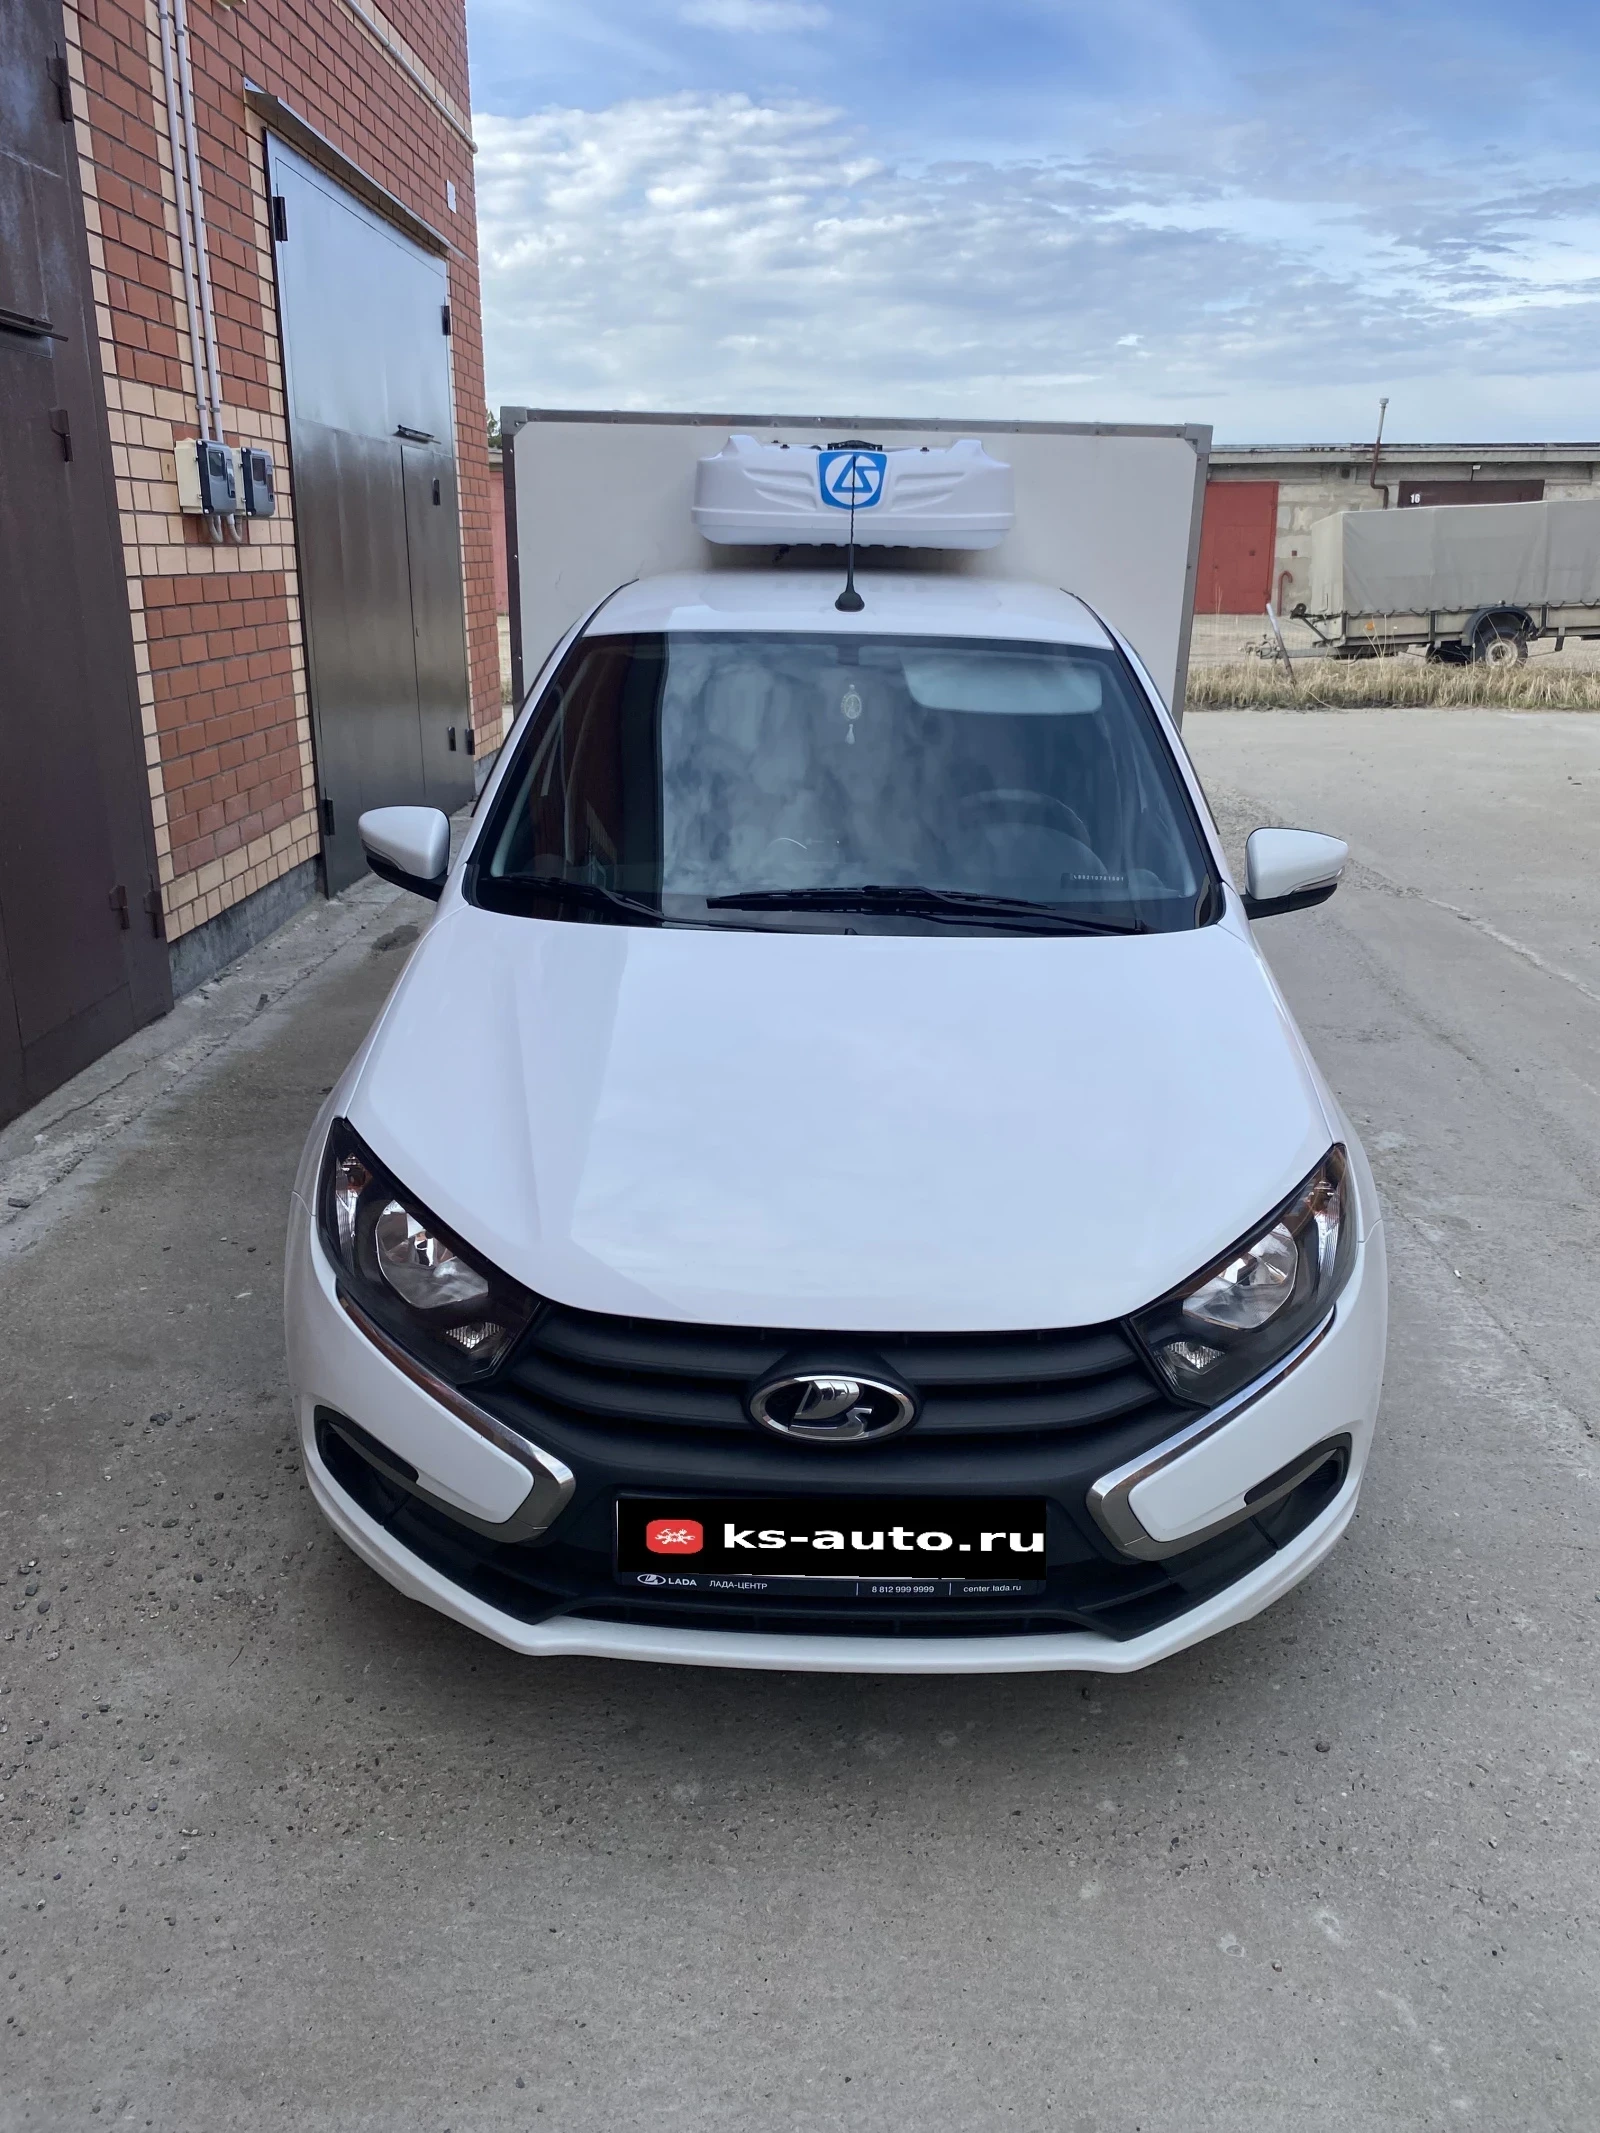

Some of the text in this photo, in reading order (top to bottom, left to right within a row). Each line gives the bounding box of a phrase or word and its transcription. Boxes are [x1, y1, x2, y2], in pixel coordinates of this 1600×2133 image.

[1411, 494, 1421, 503] 16
[668, 1577, 697, 1587] LADA
[709, 1580, 768, 1590] ЛАДА-ЦЕНТР
[871, 1585, 935, 1593] 8 812 999 9999
[963, 1584, 1022, 1593] center.lada.ru
